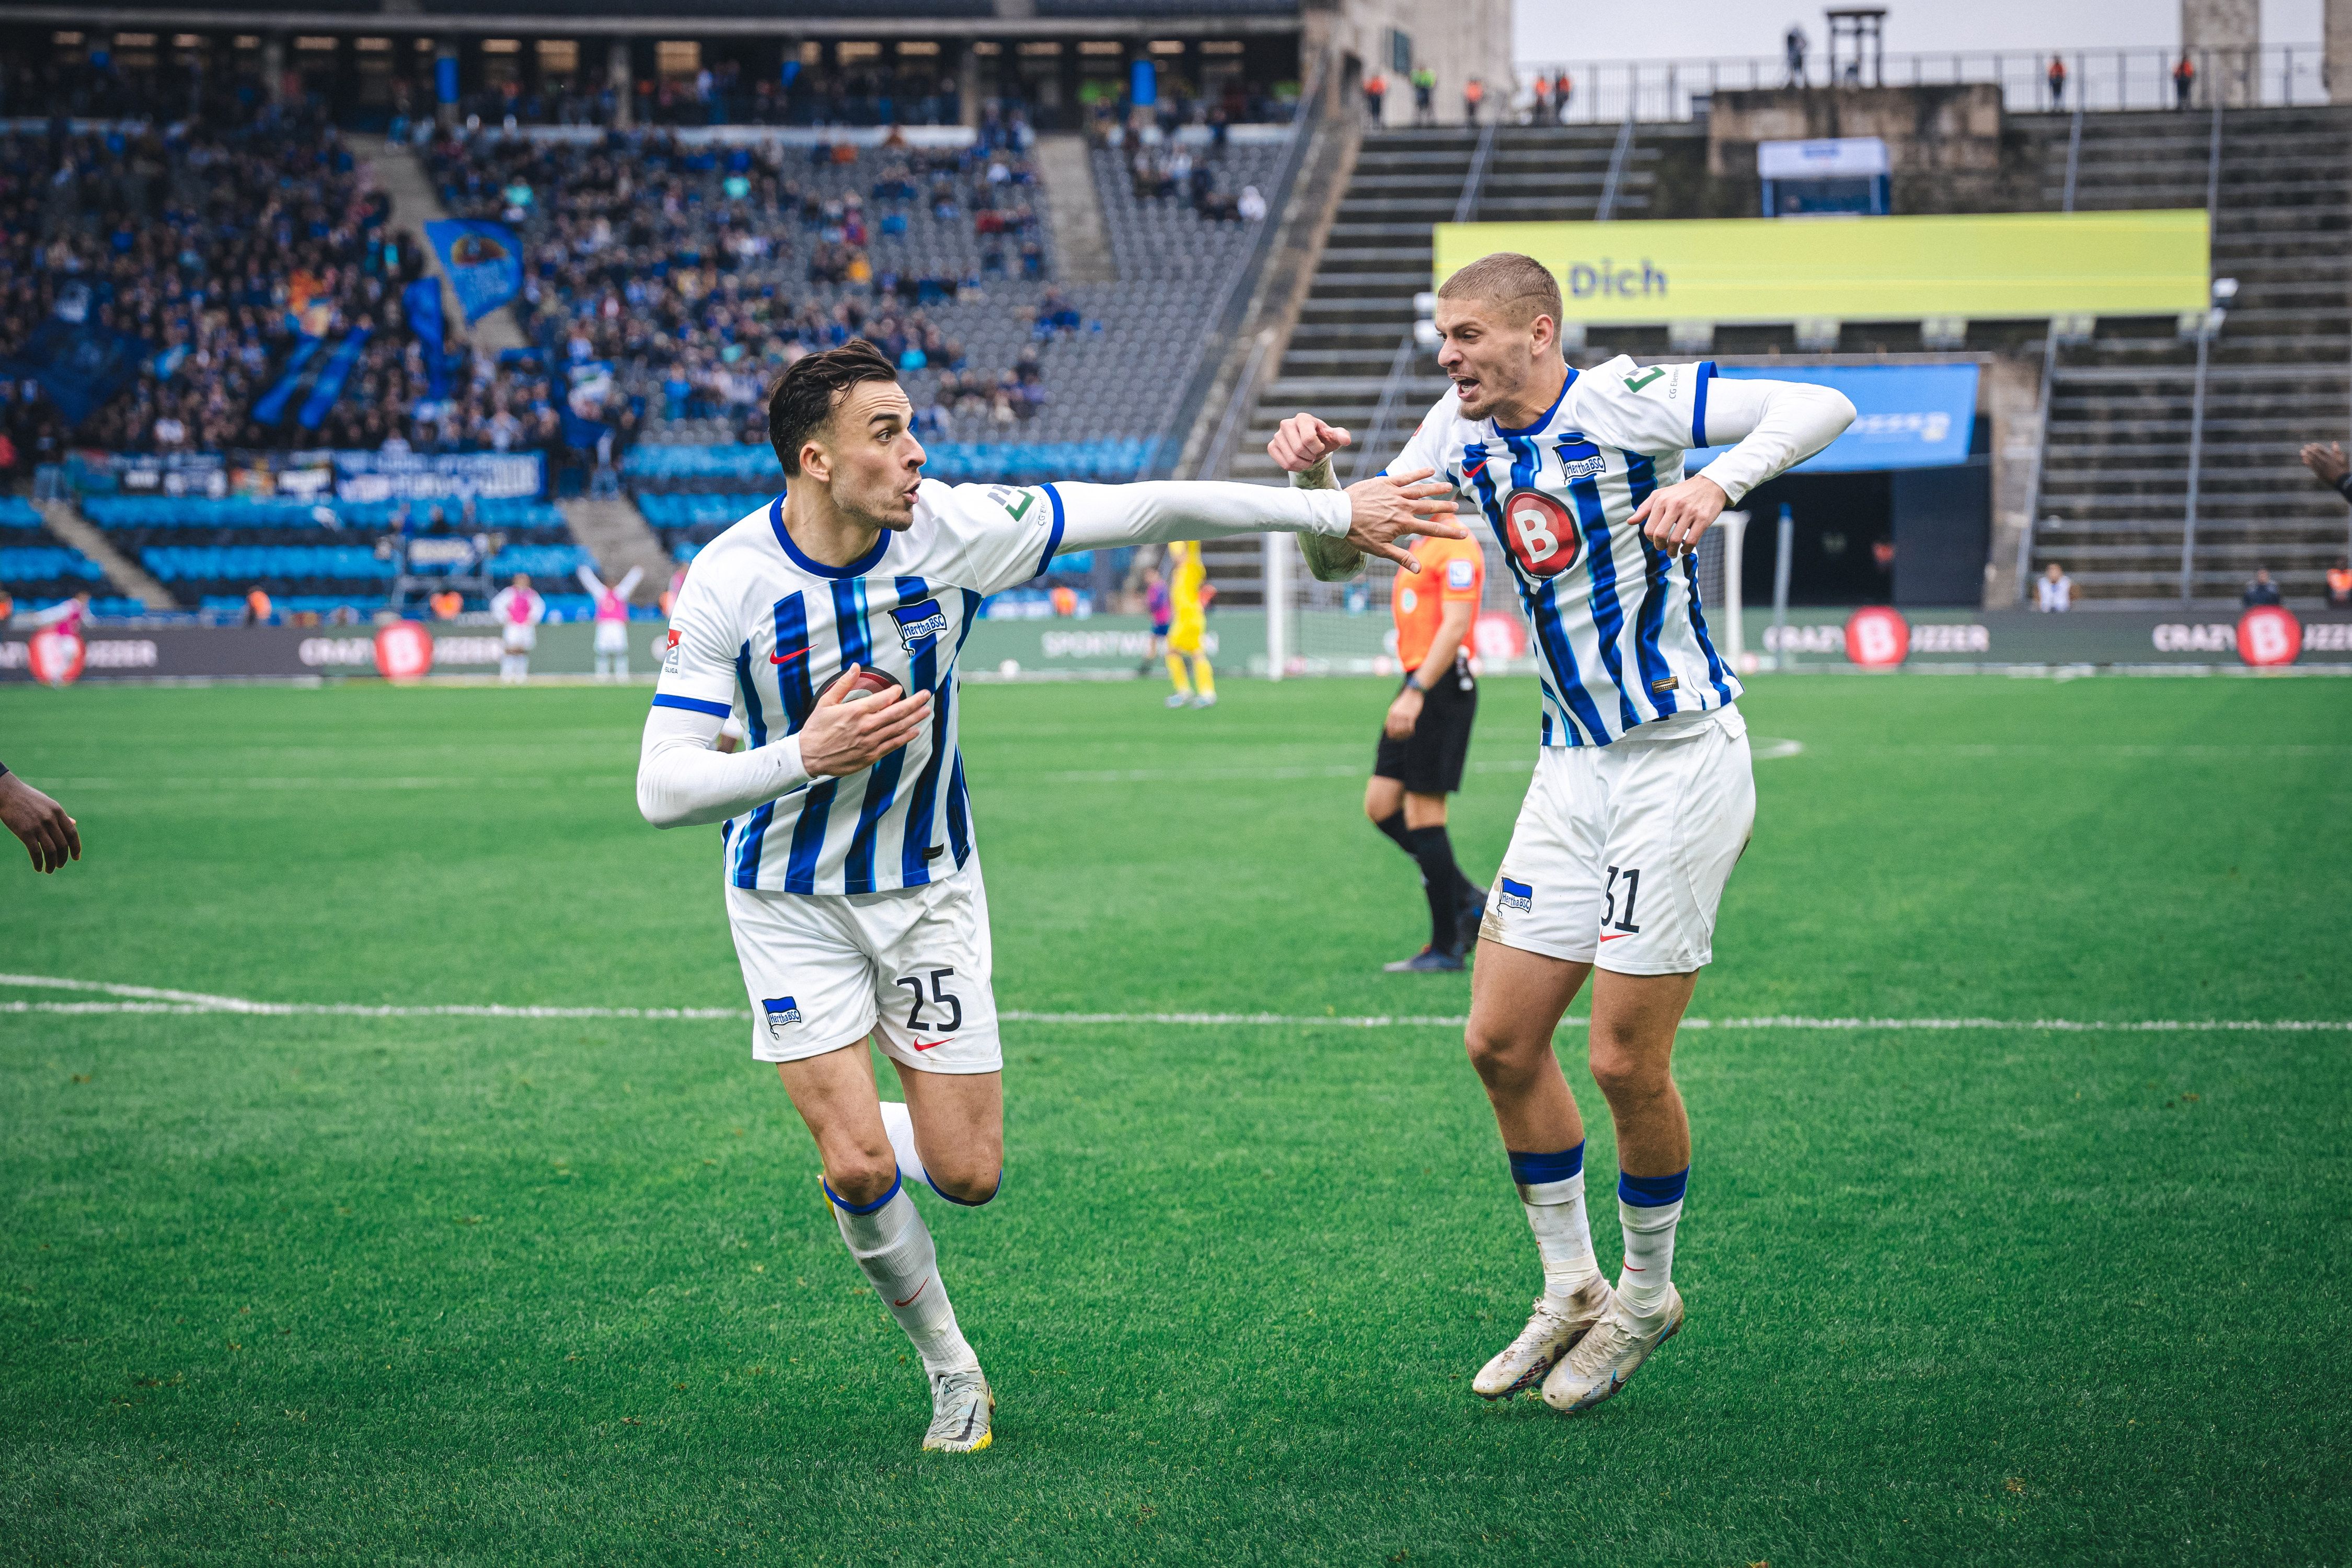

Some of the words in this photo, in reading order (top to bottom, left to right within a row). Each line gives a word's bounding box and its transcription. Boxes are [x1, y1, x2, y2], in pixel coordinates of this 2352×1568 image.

[1570, 259, 1667, 297] Dich
[1669, 389, 1676, 399] CG
[1038, 515, 1045, 526] CG
[1513, 509, 1559, 564] B
[1763, 625, 1846, 652] CRAZY
[2152, 624, 2236, 651] CRAZY
[1601, 865, 1640, 933] 31
[897, 968, 962, 1032] 25
